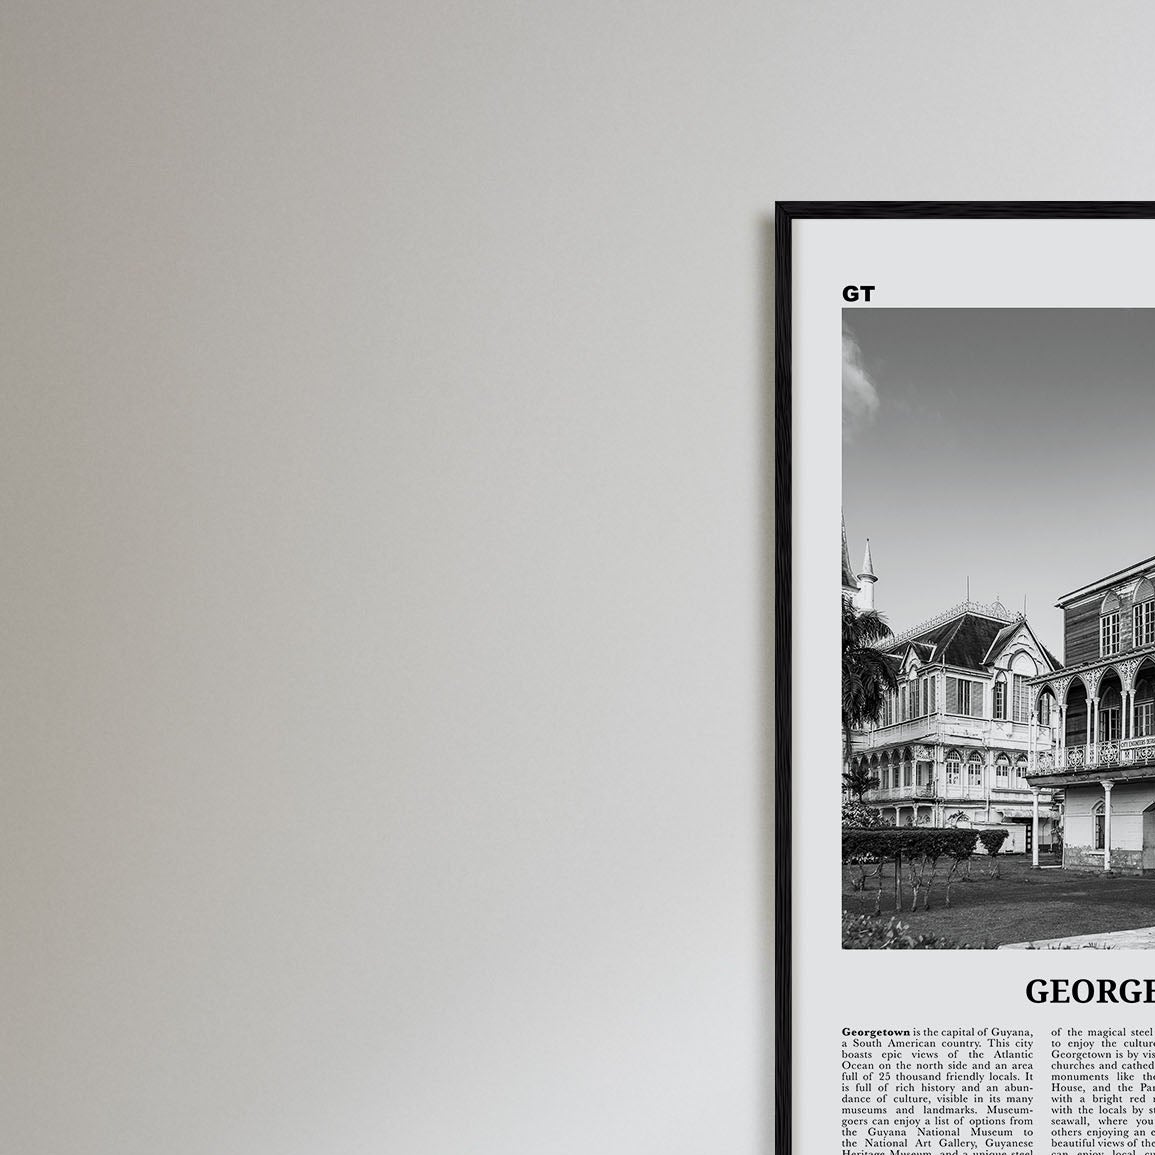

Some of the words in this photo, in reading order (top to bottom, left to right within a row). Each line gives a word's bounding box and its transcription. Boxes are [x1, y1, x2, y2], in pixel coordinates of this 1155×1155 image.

[843, 286, 875, 302] GT
[842, 1027, 910, 1039] Georgetown
[913, 1027, 921, 1037] is
[923, 1027, 938, 1037] the
[941, 1027, 974, 1039] capital
[977, 1027, 988, 1037] of
[991, 1027, 1033, 1039] Guyana,
[1051, 1027, 1062, 1037] of
[1068, 1027, 1082, 1037] the
[1088, 1027, 1126, 1039] magical
[1131, 1027, 1152, 1037] steel
[853, 1038, 882, 1048] South
[888, 1038, 936, 1048] American
[942, 1040, 981, 1050] country.
[987, 1038, 1010, 1048] This
[1015, 1038, 1034, 1050] city
[1052, 1040, 1061, 1048] to
[1068, 1038, 1095, 1050] enjoy
[1102, 1038, 1116, 1048] the
[1051, 1049, 1112, 1061] Georgetown
[1116, 1049, 1124, 1059] is
[1127, 1049, 1139, 1061] by
[842, 1061, 874, 1070] Ocean
[896, 1061, 912, 1070] the
[916, 1061, 943, 1070] north
[948, 1061, 968, 1070] side
[972, 1061, 990, 1070] and
[842, 1072, 858, 1081] full
[862, 1072, 874, 1081] of
[878, 1072, 890, 1081] 25
[896, 1072, 941, 1081] thousand
[946, 1072, 984, 1083] friendly
[990, 1072, 1020, 1081] locals.
[1026, 1072, 1033, 1081] It
[842, 1094, 870, 1103] dance
[876, 1094, 888, 1103] of
[893, 1094, 931, 1105] culture,
[937, 1094, 968, 1103] visible
[974, 1094, 984, 1103] in
[990, 1094, 1000, 1103] its
[1006, 1097, 1034, 1106] many
[1051, 1094, 1072, 1103] with
[1092, 1094, 1122, 1106] bright
[1130, 1094, 1146, 1103] red
[1051, 1105, 1072, 1115] with
[1078, 1105, 1094, 1115] the
[1099, 1105, 1127, 1115] locals
[1132, 1105, 1144, 1117] by
[841, 1119, 868, 1128] goers
[894, 1116, 920, 1128] enjoy
[935, 1116, 949, 1126] list
[954, 1116, 965, 1126] of
[969, 1116, 1006, 1128] options
[1010, 1116, 1033, 1126] from
[1051, 1127, 1082, 1137] others
[1086, 1127, 1129, 1139] enjoying
[842, 1138, 857, 1148] the
[865, 1138, 908, 1148] National
[915, 1138, 931, 1148] Art
[939, 1138, 978, 1150] Gallery,
[985, 1138, 1033, 1150] Guyanese
